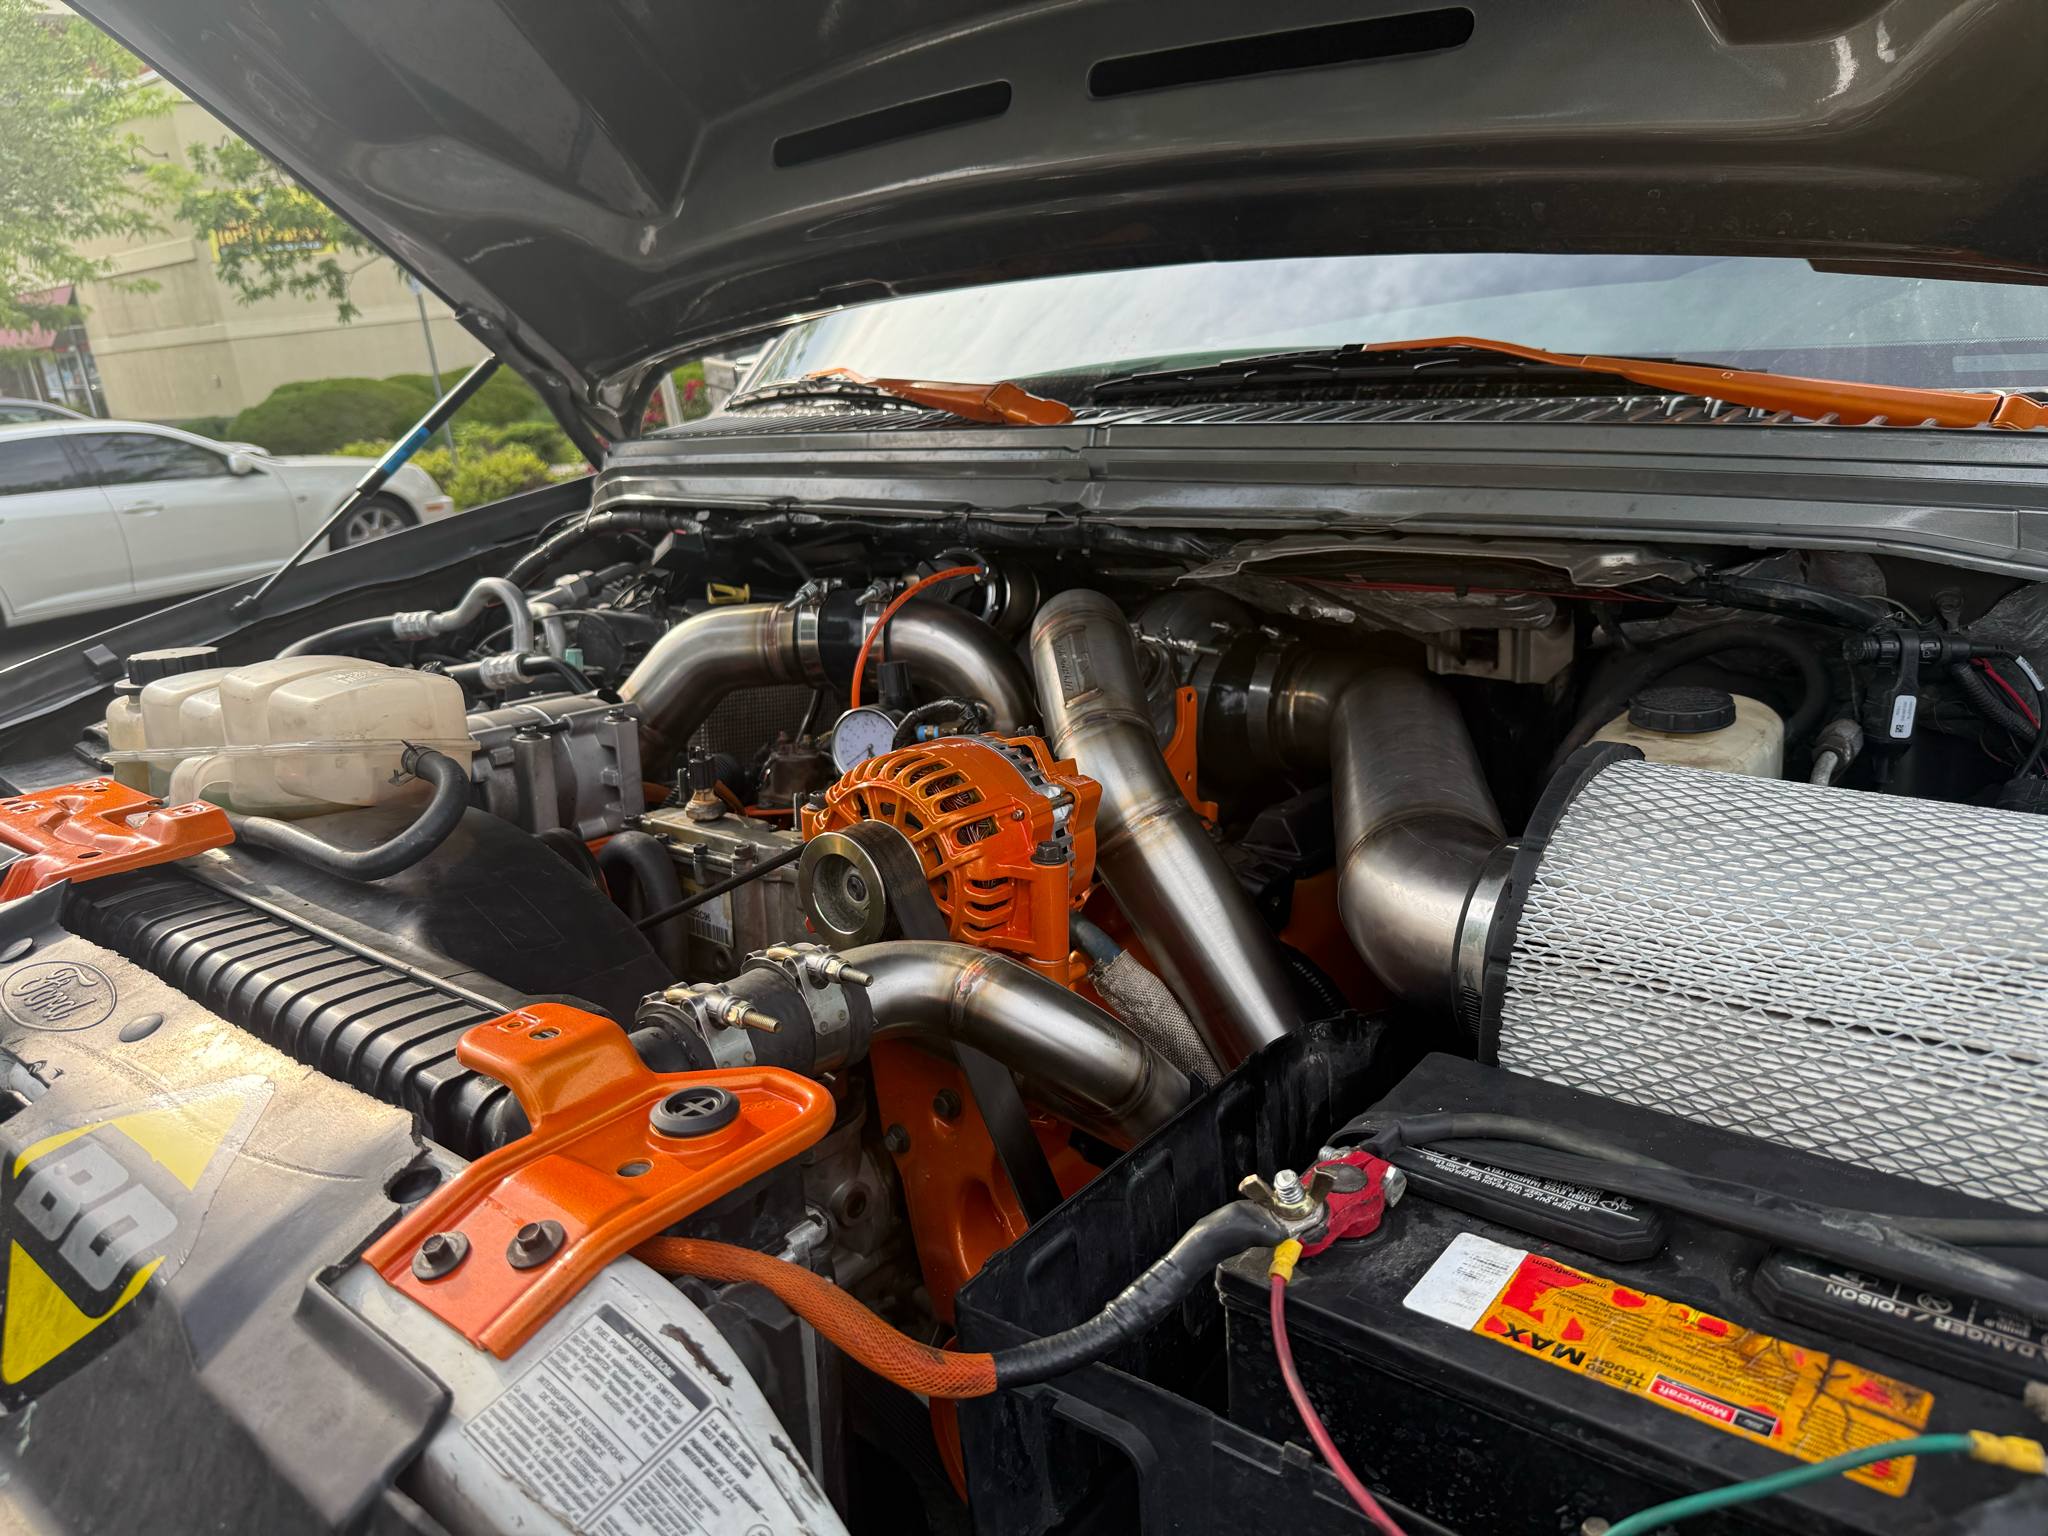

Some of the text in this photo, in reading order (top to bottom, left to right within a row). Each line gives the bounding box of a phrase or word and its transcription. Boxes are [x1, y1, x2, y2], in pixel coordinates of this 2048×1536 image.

[11, 966, 99, 1021] Ford
[1445, 1161, 1460, 1170] AND
[1462, 1166, 1482, 1177] TIGHT
[1484, 1164, 1541, 1187] IMMEDIATELY
[1435, 1162, 1571, 1210] KEEP OUT OF THE REACH OF CHILDREN
[1484, 1174, 1503, 1184] CAPS
[1504, 1180, 1522, 1190] VENT
[1523, 1186, 1543, 1197] KEEP
[1542, 1183, 1566, 1195] EYES
[1561, 1198, 1577, 1207] NOT
[1567, 1191, 1597, 1205] FLUSH
[1530, 1256, 1607, 1290] motorcraft.com
[1823, 1281, 1909, 1318] POISON
[1498, 1320, 1586, 1367] MAX
[1931, 1316, 2036, 1358] DANGER
[592, 1324, 684, 1410] FUEL PUMP SHUT-OFF SWITCH
[1584, 1360, 1643, 1388] TESTED
[1593, 1355, 1646, 1380] TOUGH
[1657, 1382, 1729, 1417] Motorcraft
